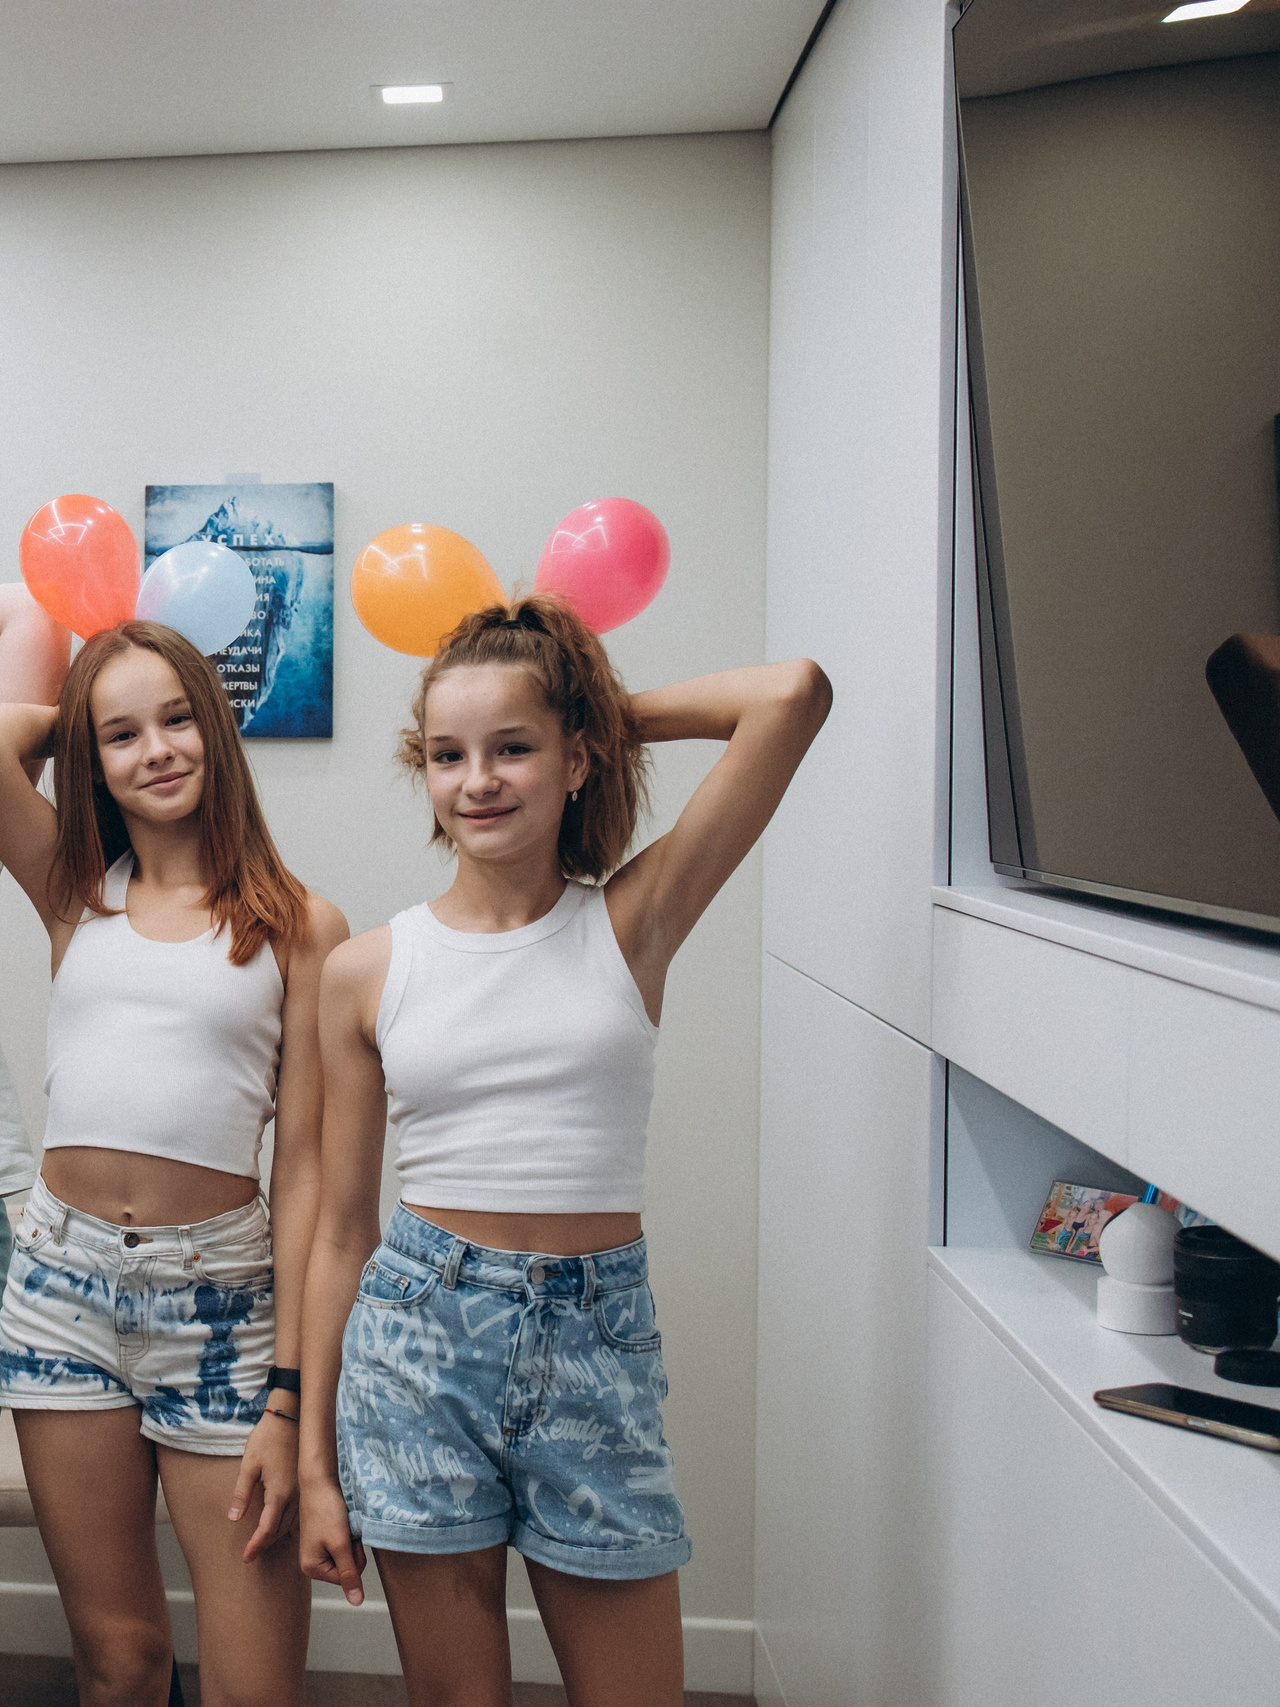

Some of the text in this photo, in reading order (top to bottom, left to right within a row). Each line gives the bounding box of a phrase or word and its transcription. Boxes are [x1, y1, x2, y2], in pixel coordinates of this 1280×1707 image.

[244, 557, 285, 568] БОТАТЬ
[216, 663, 261, 674] ОТКАЗЫ
[229, 699, 256, 709] ИСКИ
